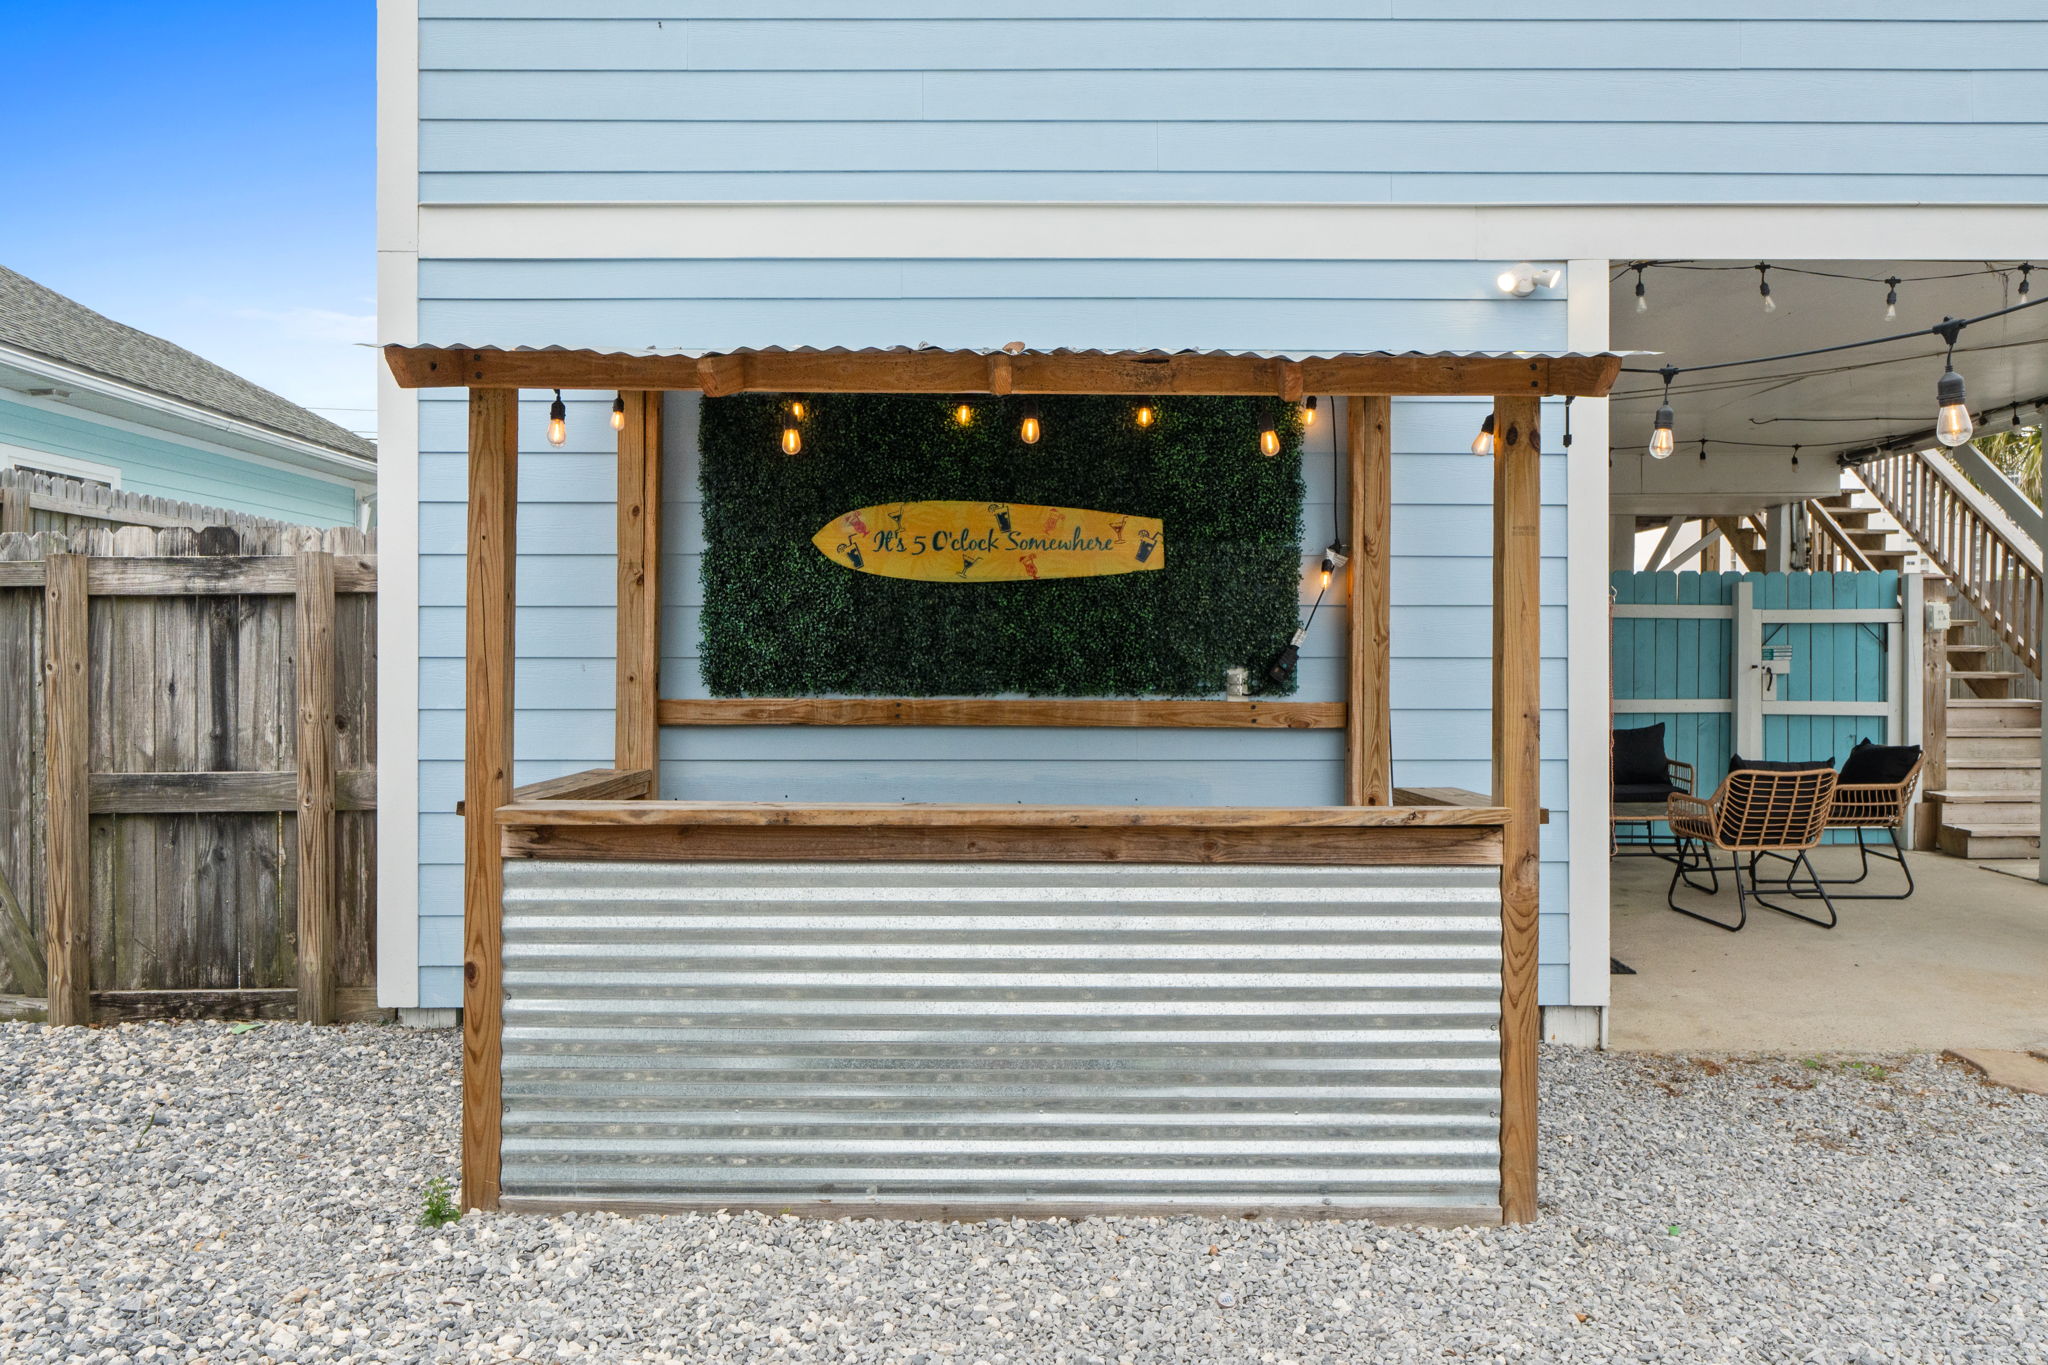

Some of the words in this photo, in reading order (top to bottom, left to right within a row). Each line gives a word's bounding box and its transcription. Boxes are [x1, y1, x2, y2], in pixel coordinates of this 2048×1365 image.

[873, 530, 906, 552] It's
[912, 536, 927, 555] 5
[932, 529, 999, 552] O'clock
[1005, 526, 1114, 552] Somewhere
